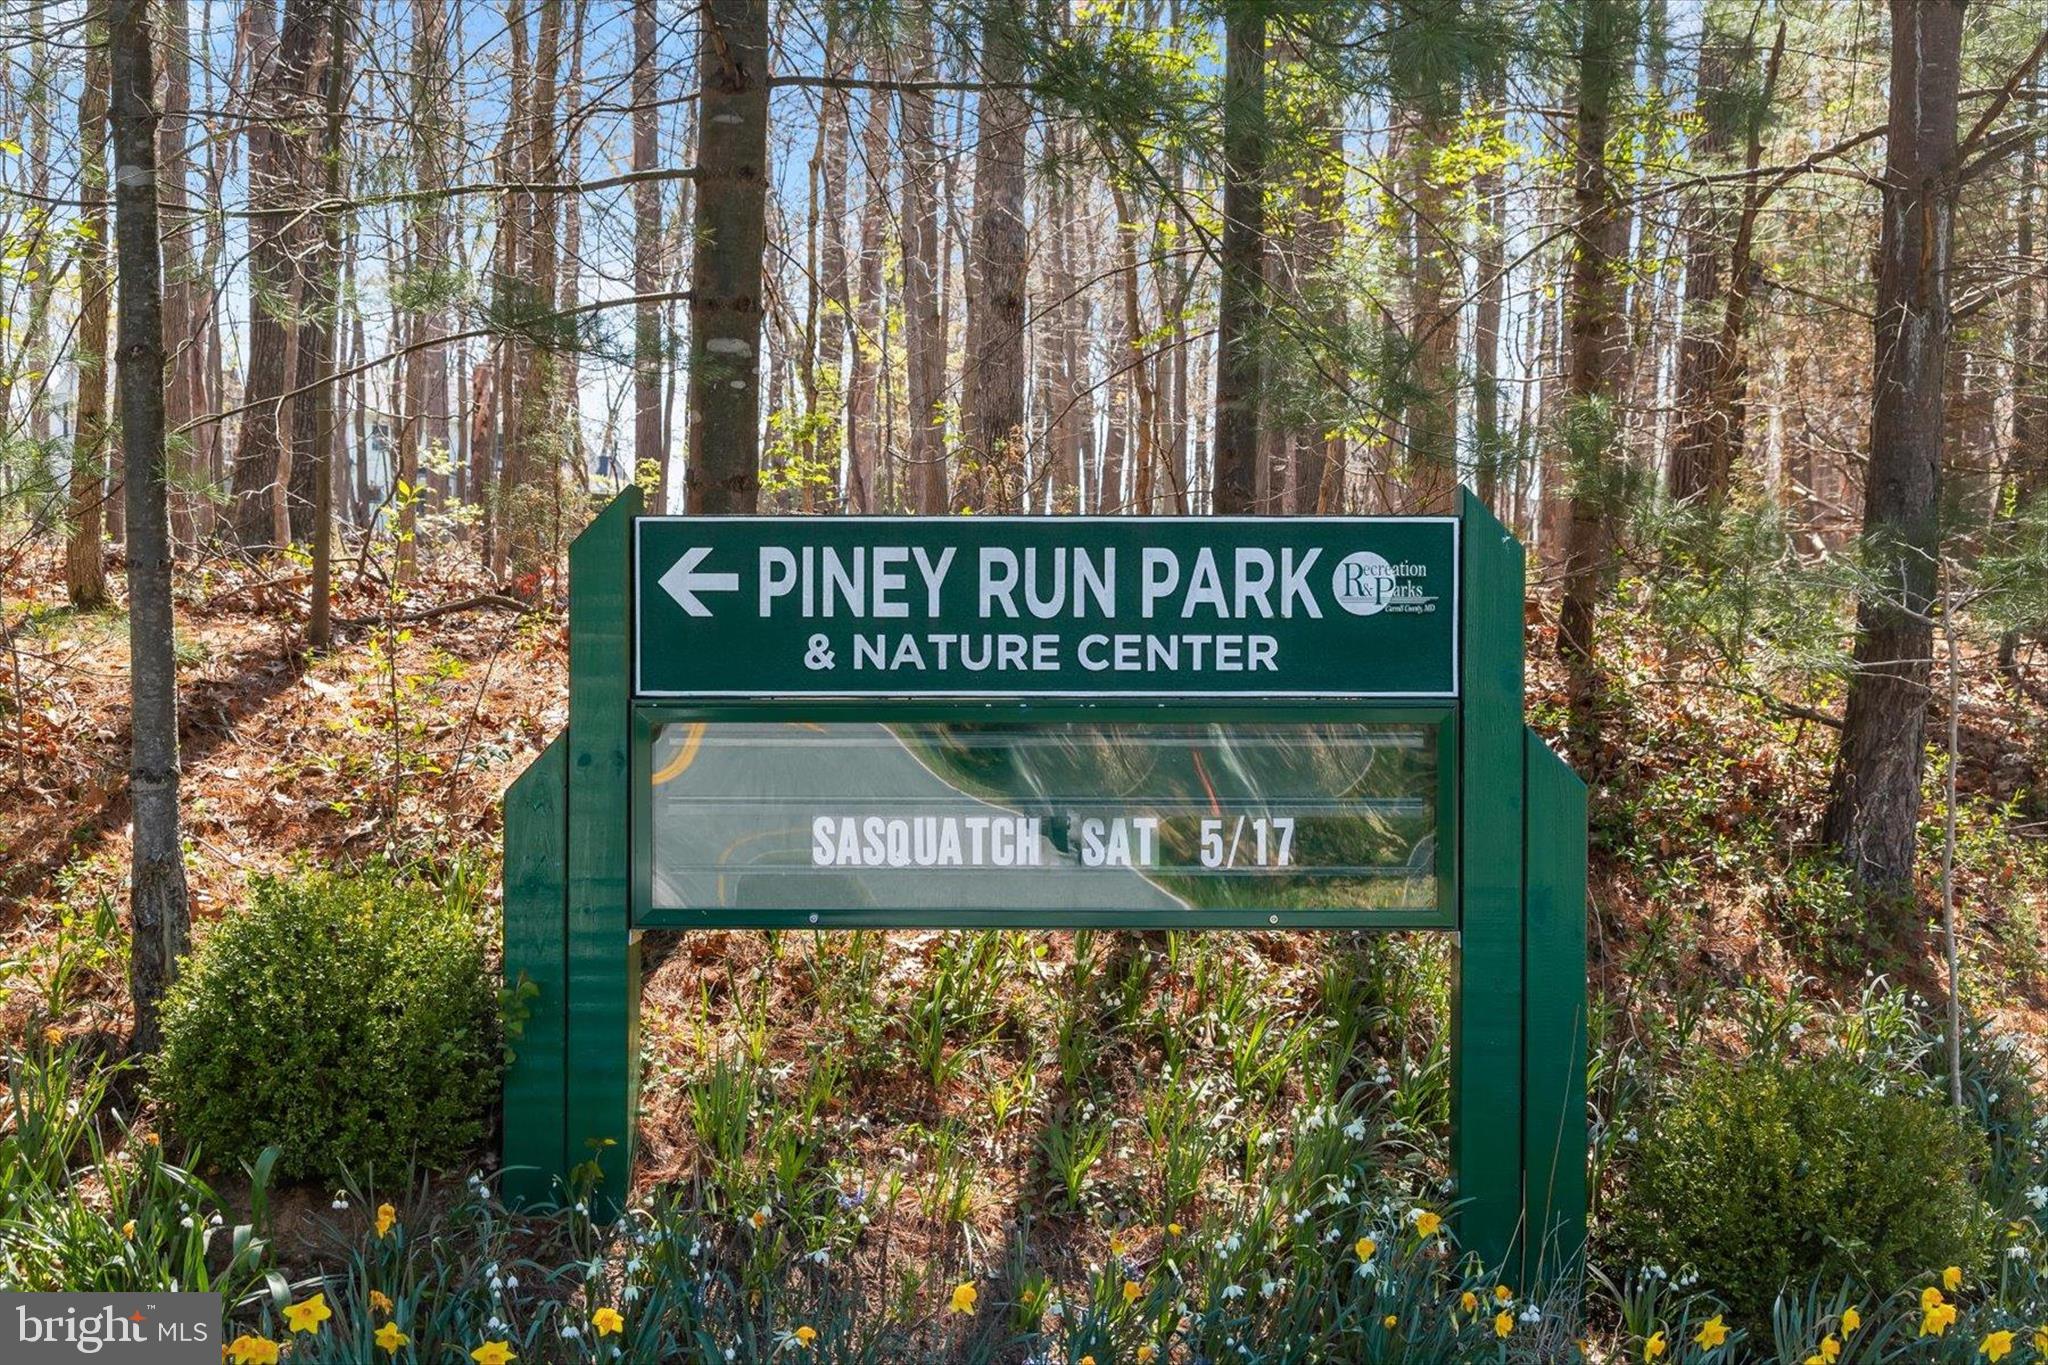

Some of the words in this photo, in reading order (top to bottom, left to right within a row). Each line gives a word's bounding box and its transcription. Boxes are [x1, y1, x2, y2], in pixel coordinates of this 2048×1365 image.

[759, 546, 957, 618] PINEY
[979, 547, 1116, 618] RUN
[1142, 547, 1324, 618] PARK
[1343, 560, 1427, 597] Recreation
[1375, 577, 1423, 605] Parks
[804, 633, 835, 671] &
[853, 634, 1060, 671] NATURE
[1077, 634, 1279, 671] CENTER
[812, 816, 1042, 868] SASQUATCH
[1081, 817, 1158, 868] SAT
[1200, 816, 1295, 870] 5/17
